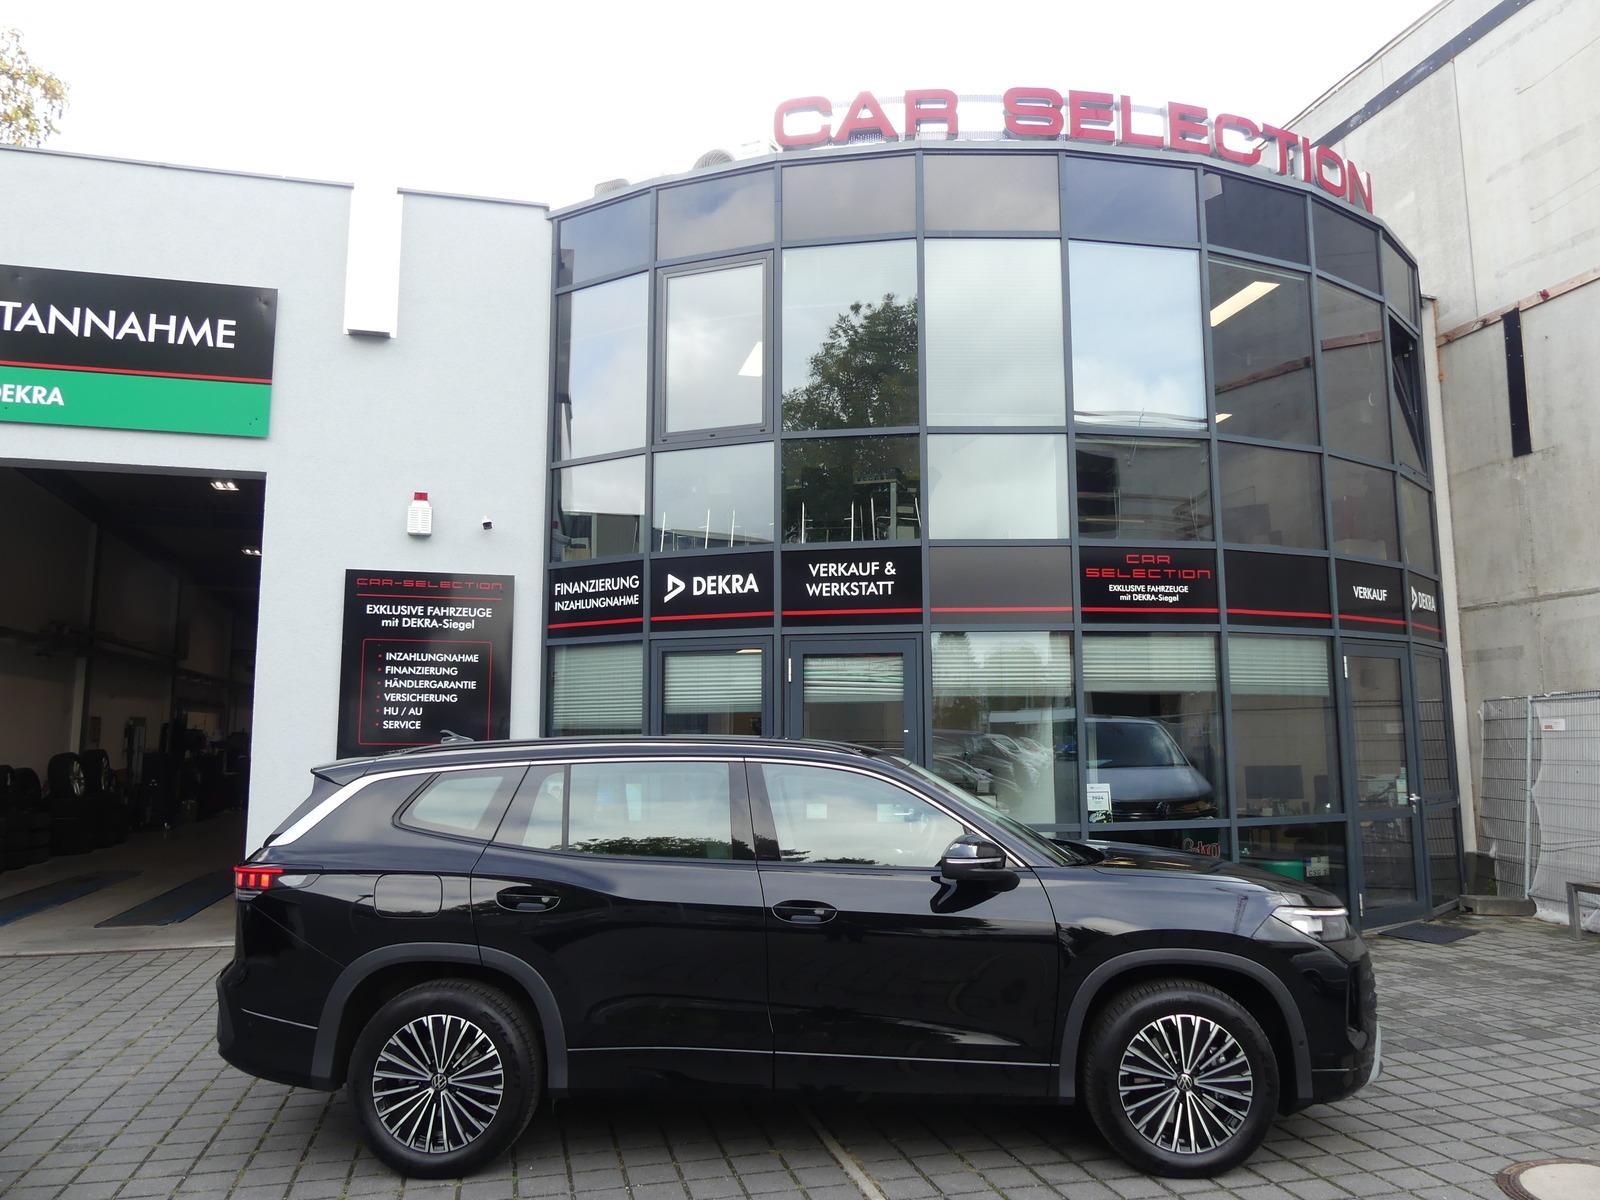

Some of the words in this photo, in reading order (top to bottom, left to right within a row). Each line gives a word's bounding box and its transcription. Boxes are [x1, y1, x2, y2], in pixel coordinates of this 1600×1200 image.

[774, 89, 959, 148] CAR
[1003, 86, 1373, 213] SELECTION
[0, 300, 237, 349] TANNAHME
[0, 384, 65, 406] EKRA
[1125, 554, 1172, 565] CAR
[808, 561, 880, 577] VERKAUF
[884, 561, 897, 576] &
[1085, 567, 1211, 580] SELECTION
[554, 575, 640, 597] FINANZIERUNG
[692, 573, 760, 596] DEKRA
[805, 581, 895, 597] WERKSTATT
[1108, 584, 1146, 593] EXKLUSIVE
[1147, 585, 1189, 594] FAHRZEUGE
[1119, 593, 1131, 602] mit
[1132, 594, 1180, 603] DEKRA-Siegel
[1352, 585, 1388, 602] VERKAUF
[554, 594, 640, 612] INZAHLUNGNAHME
[1417, 591, 1436, 613] DEKRA
[366, 604, 424, 616] EXKLUSIVE
[427, 606, 493, 618] FAHRZEUGE
[381, 617, 399, 628] mit
[402, 618, 475, 632] DEKRA-Siegel
[385, 652, 479, 663] INZAHLUNGNAHME
[385, 665, 459, 676] FINANZIERUNG
[384, 677, 477, 690] HÄNDLERGARANTIE
[383, 692, 458, 703] VERSICHERUNG
[383, 706, 399, 716] HU
[408, 706, 423, 716] AU
[382, 720, 422, 730] SERVICE
